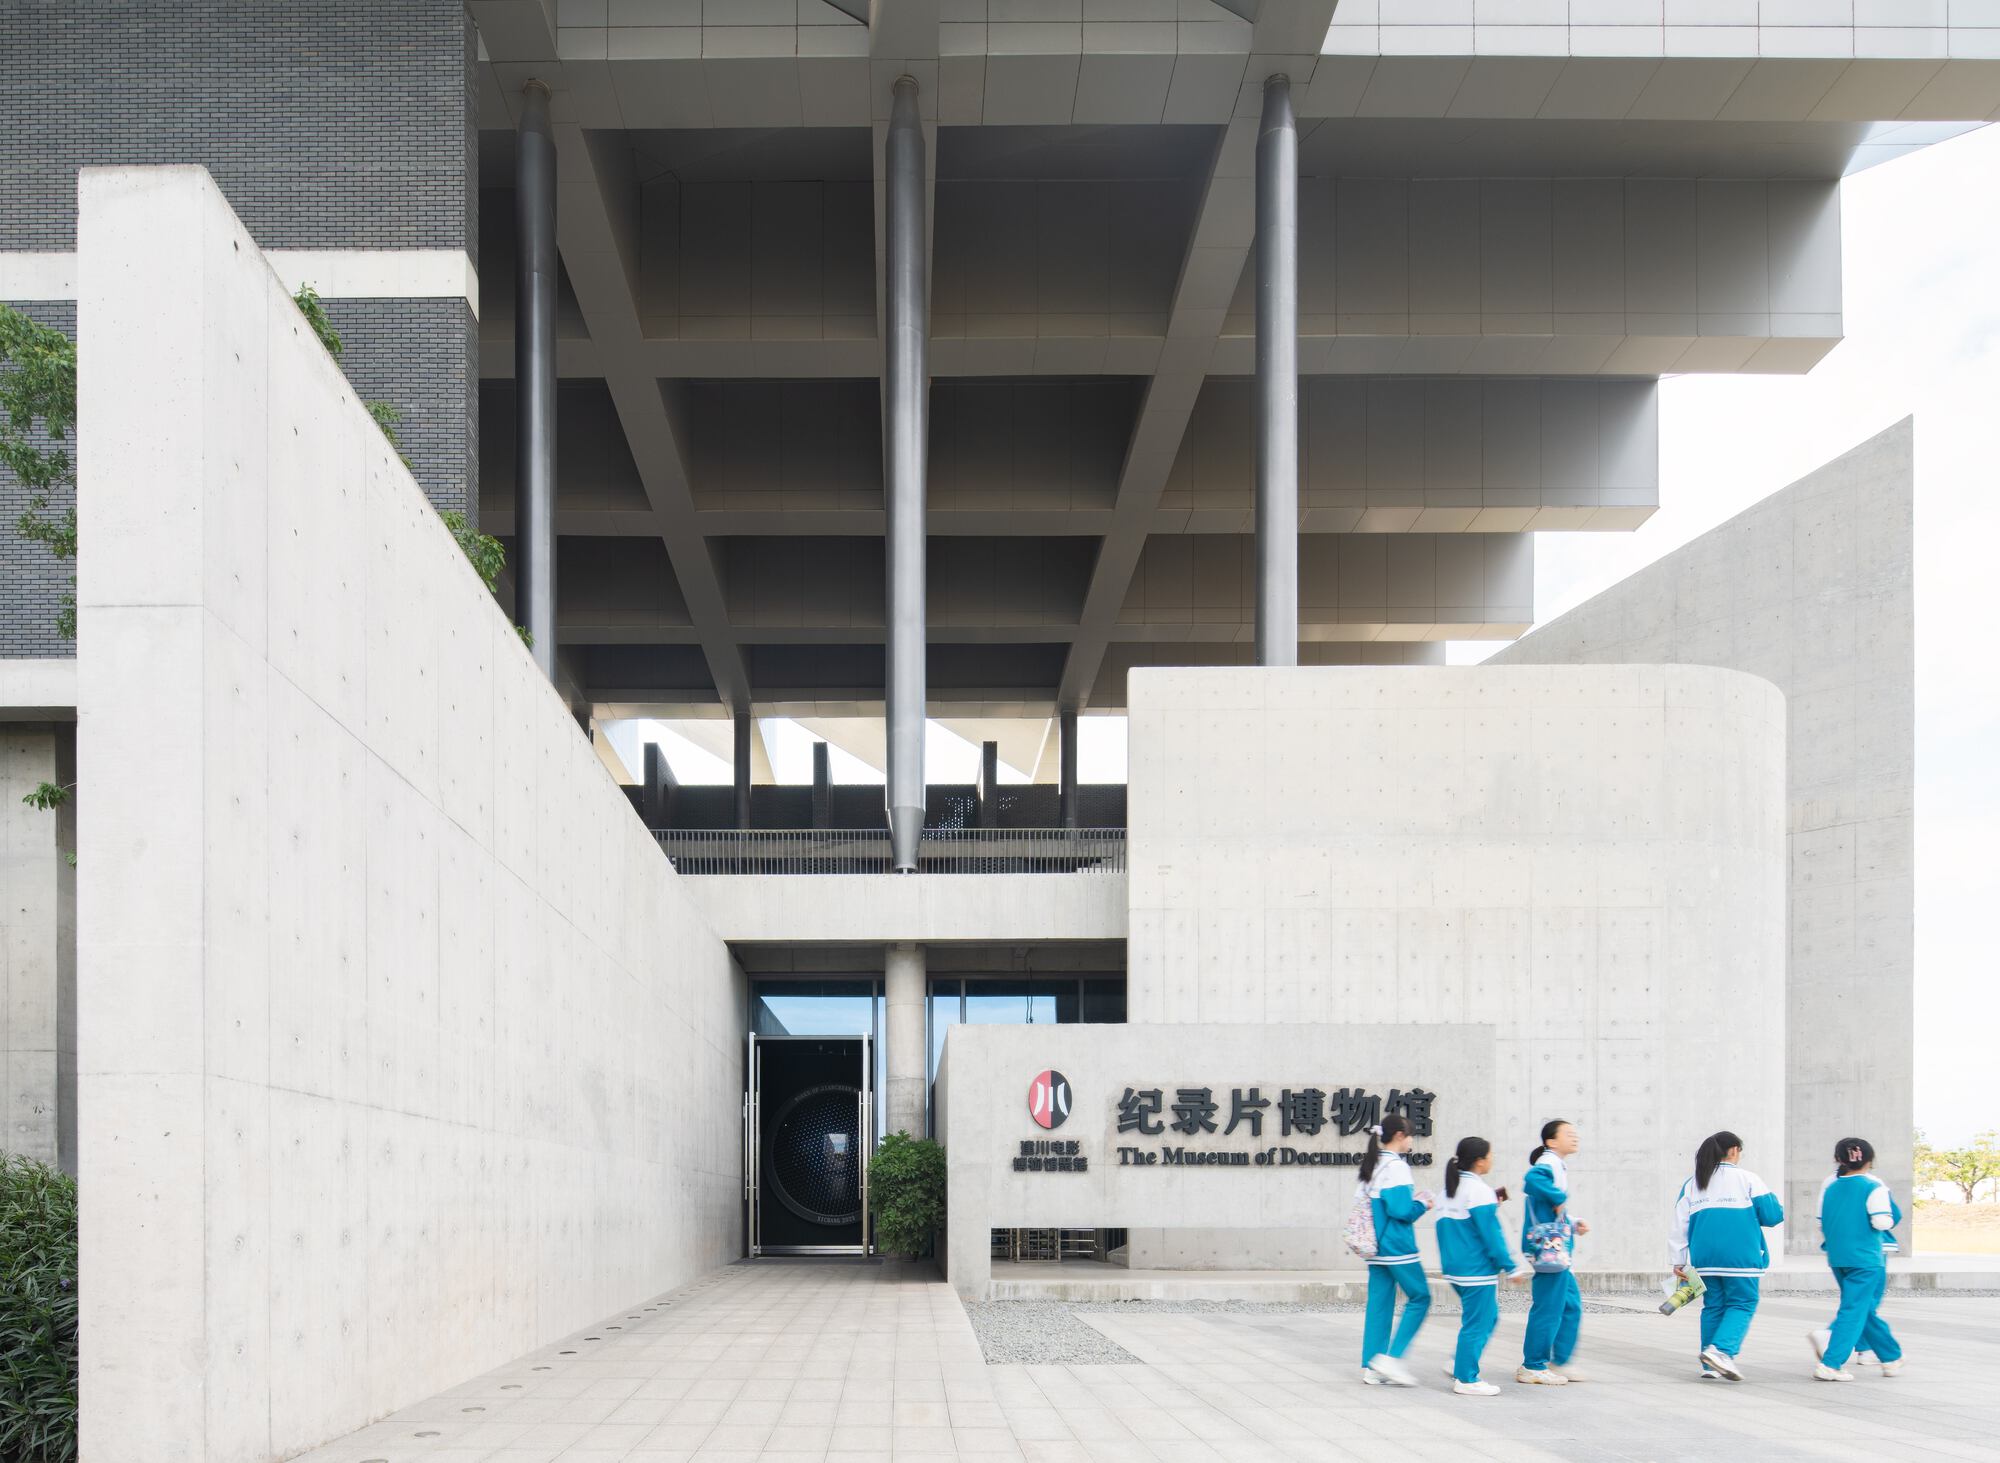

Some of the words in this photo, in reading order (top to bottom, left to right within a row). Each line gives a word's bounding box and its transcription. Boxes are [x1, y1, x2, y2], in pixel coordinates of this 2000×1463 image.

[1117, 1087, 1437, 1137] 纪录片博物馆
[1020, 1140, 1080, 1156] 建川电影
[1117, 1147, 1157, 1165] The
[1161, 1147, 1250, 1165] Museum
[1254, 1147, 1277, 1165] of
[1279, 1147, 1433, 1166] Documeies
